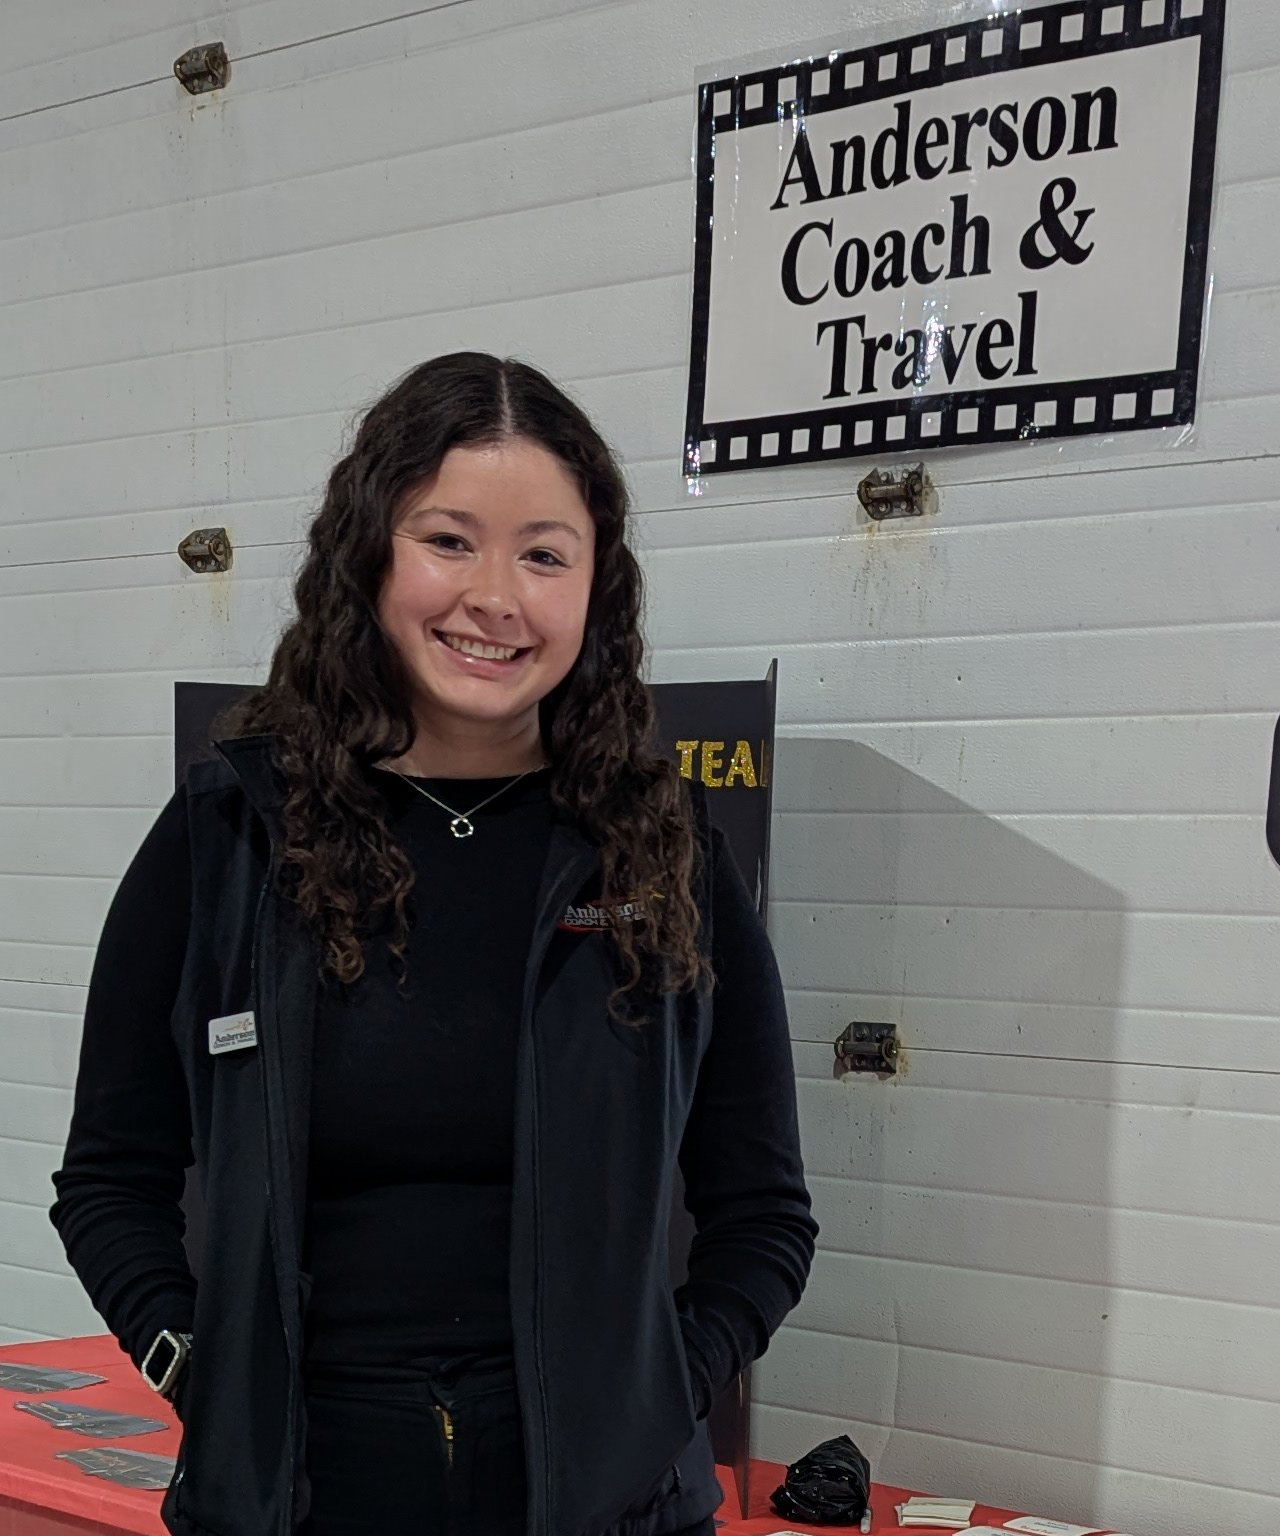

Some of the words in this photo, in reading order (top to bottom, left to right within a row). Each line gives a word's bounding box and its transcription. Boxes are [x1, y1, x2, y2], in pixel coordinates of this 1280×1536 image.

[770, 85, 1119, 211] Anderson
[780, 192, 992, 305] Coach
[1019, 176, 1096, 271] &
[816, 291, 1038, 400] Travel
[676, 740, 770, 788] TEA
